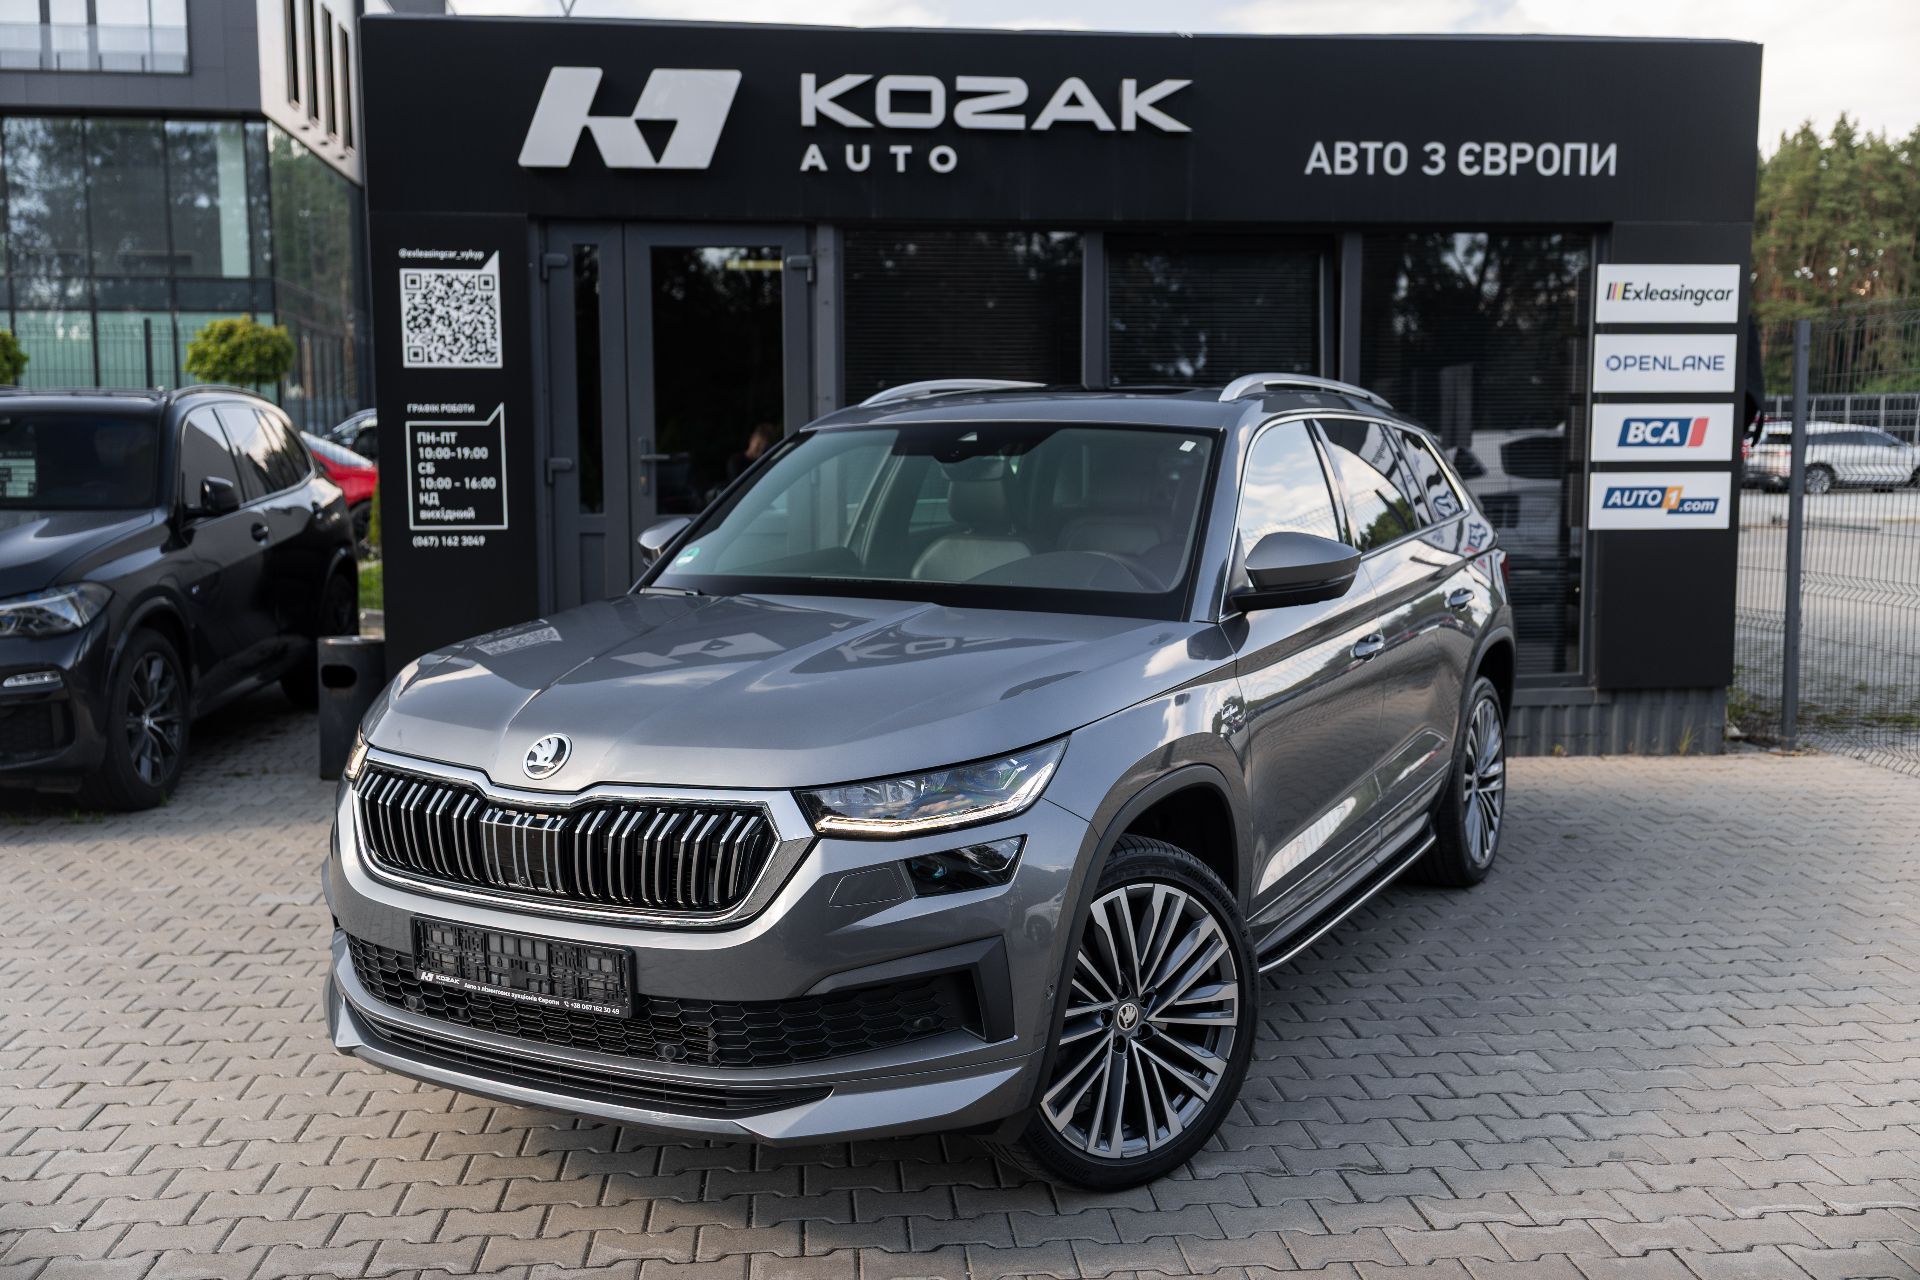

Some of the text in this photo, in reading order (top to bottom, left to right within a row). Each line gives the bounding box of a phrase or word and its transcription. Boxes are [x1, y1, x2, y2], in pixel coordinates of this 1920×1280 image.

[800, 73, 1193, 132] KOZAK
[800, 143, 958, 173] AUTO
[1304, 141, 1618, 177] АВТО З ЄВРОПИ
[1621, 282, 1734, 307] Exleasingcar
[1605, 355, 1726, 372] OPENLANE
[440, 403, 475, 414] РОБОТИ
[417, 431, 458, 444] ПН-ПТ
[1626, 420, 1681, 444] BCA
[418, 446, 489, 460] 10:00-19:00
[417, 461, 436, 475] СБ
[420, 477, 453, 490] 10:00
[463, 477, 497, 490] 16:00
[419, 491, 440, 506] НД
[419, 506, 476, 521] вихідний
[412, 535, 440, 548] (067)
[441, 535, 460, 547] 162
[435, 974, 460, 985] KOZAK
[538, 996, 560, 1006] Європи
[593, 1005, 603, 1013] 162
[603, 1006, 611, 1014] 30
